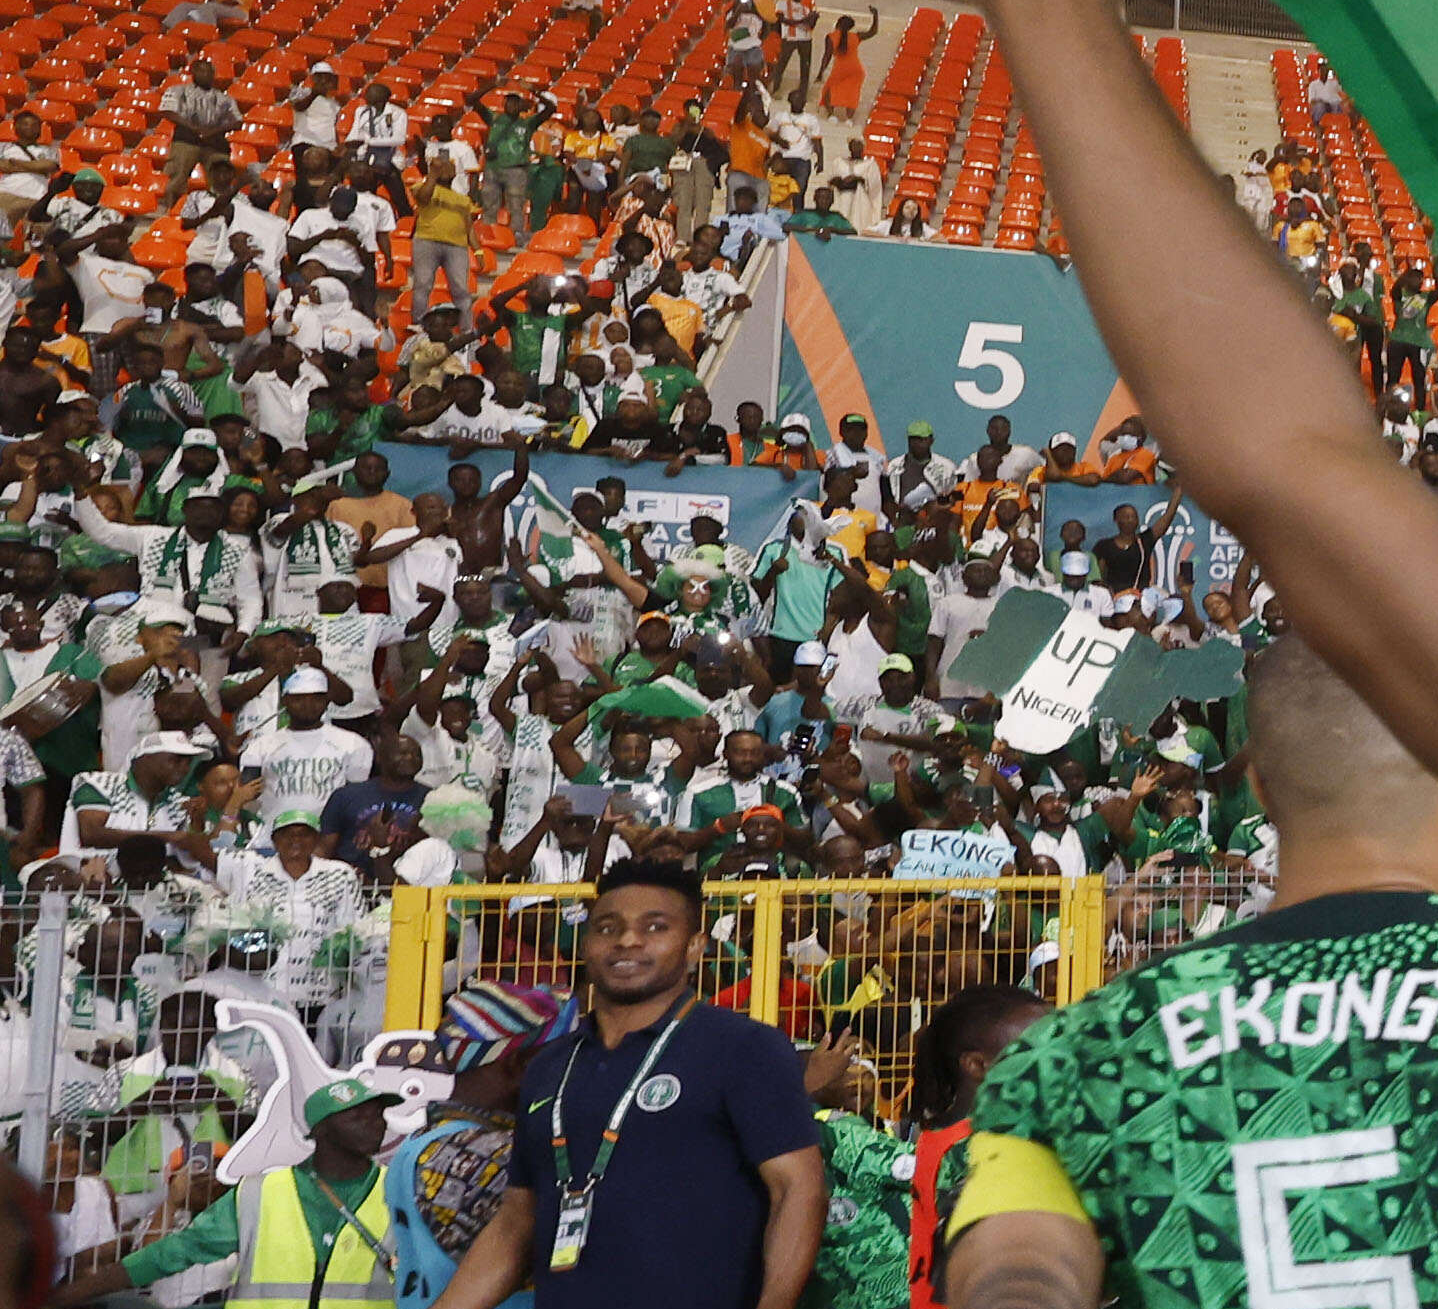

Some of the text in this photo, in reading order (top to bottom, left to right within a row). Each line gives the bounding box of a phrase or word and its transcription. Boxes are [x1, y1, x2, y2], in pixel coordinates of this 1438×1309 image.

[954, 321, 1025, 409] 5
[1051, 630, 1119, 688] UP
[1011, 687, 1082, 725] NIGERI
[909, 833, 1005, 868] EKONG
